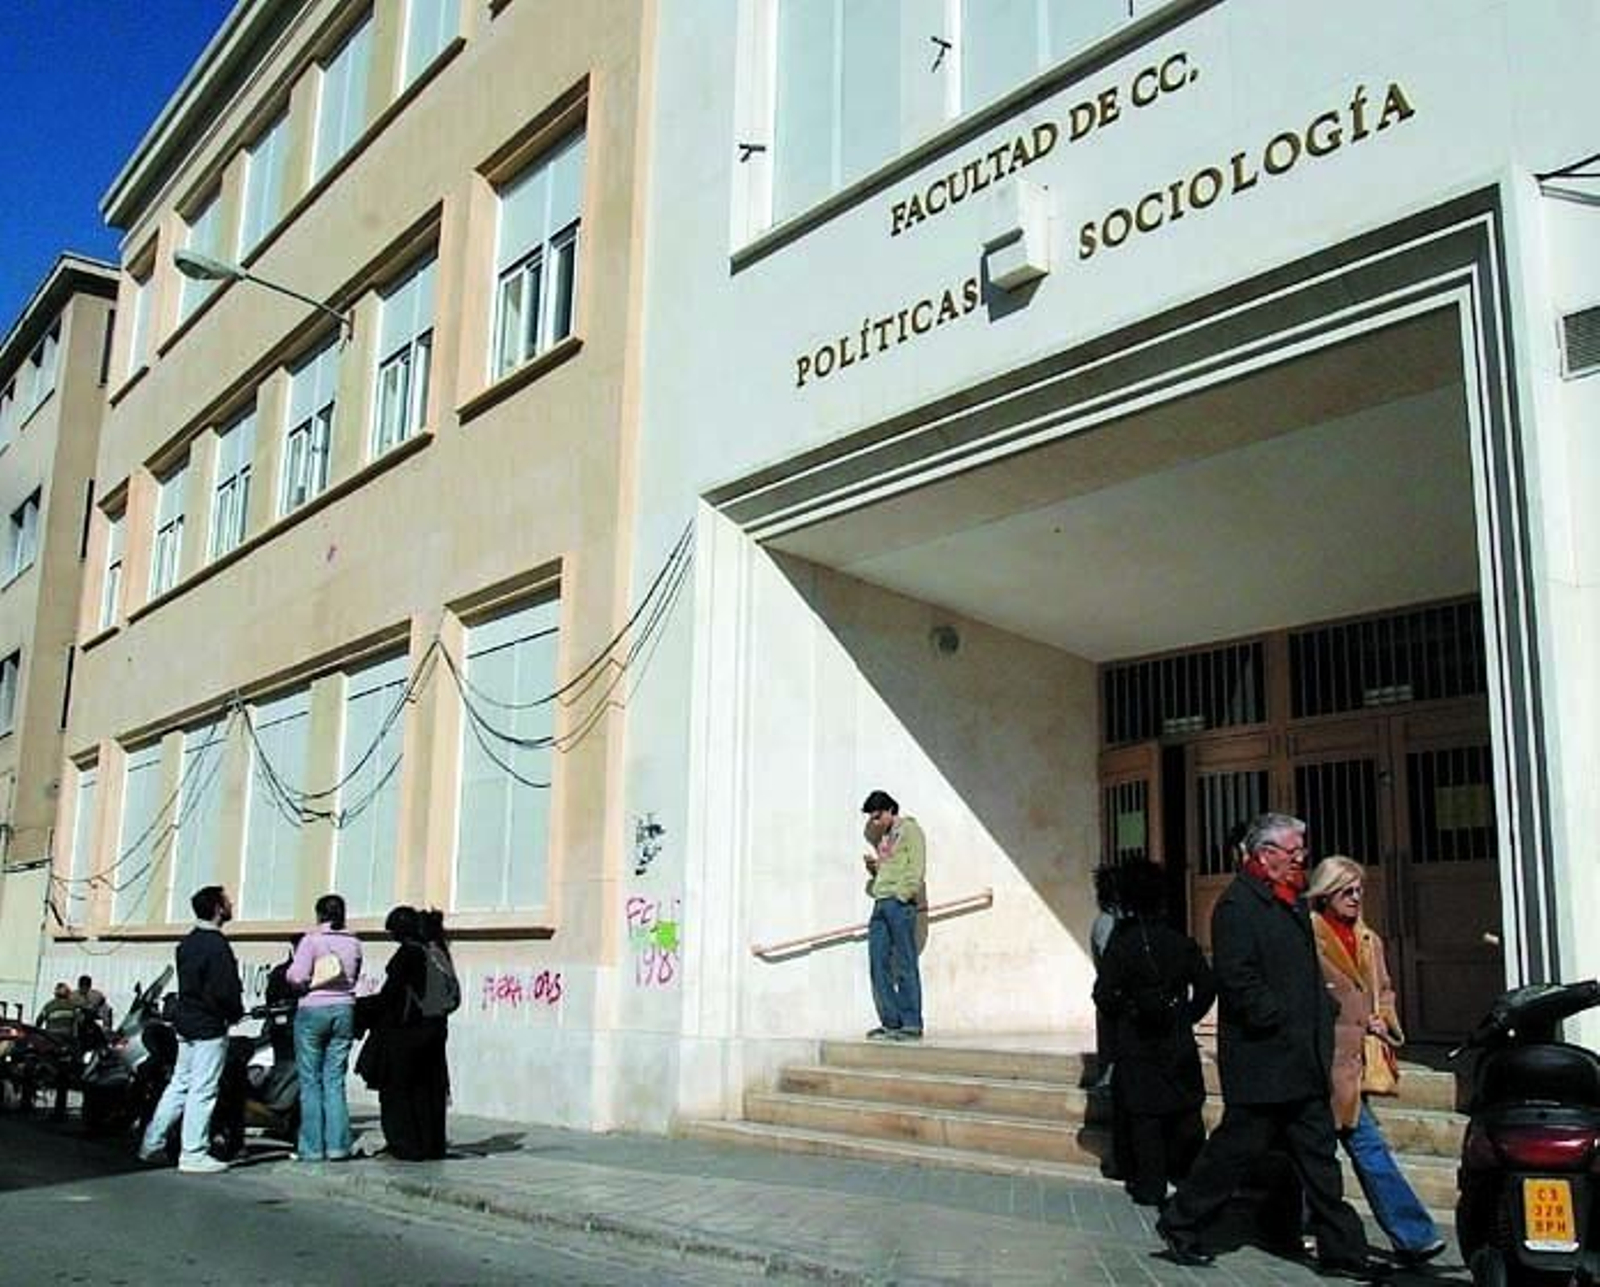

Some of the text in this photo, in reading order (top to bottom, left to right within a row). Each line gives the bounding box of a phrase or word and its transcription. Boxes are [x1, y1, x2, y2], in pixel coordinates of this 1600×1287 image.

[795, 82, 1415, 388] POLÍTICAS SOCIOLOGÍA
[890, 52, 1200, 236] FACULTAD DE CC.
